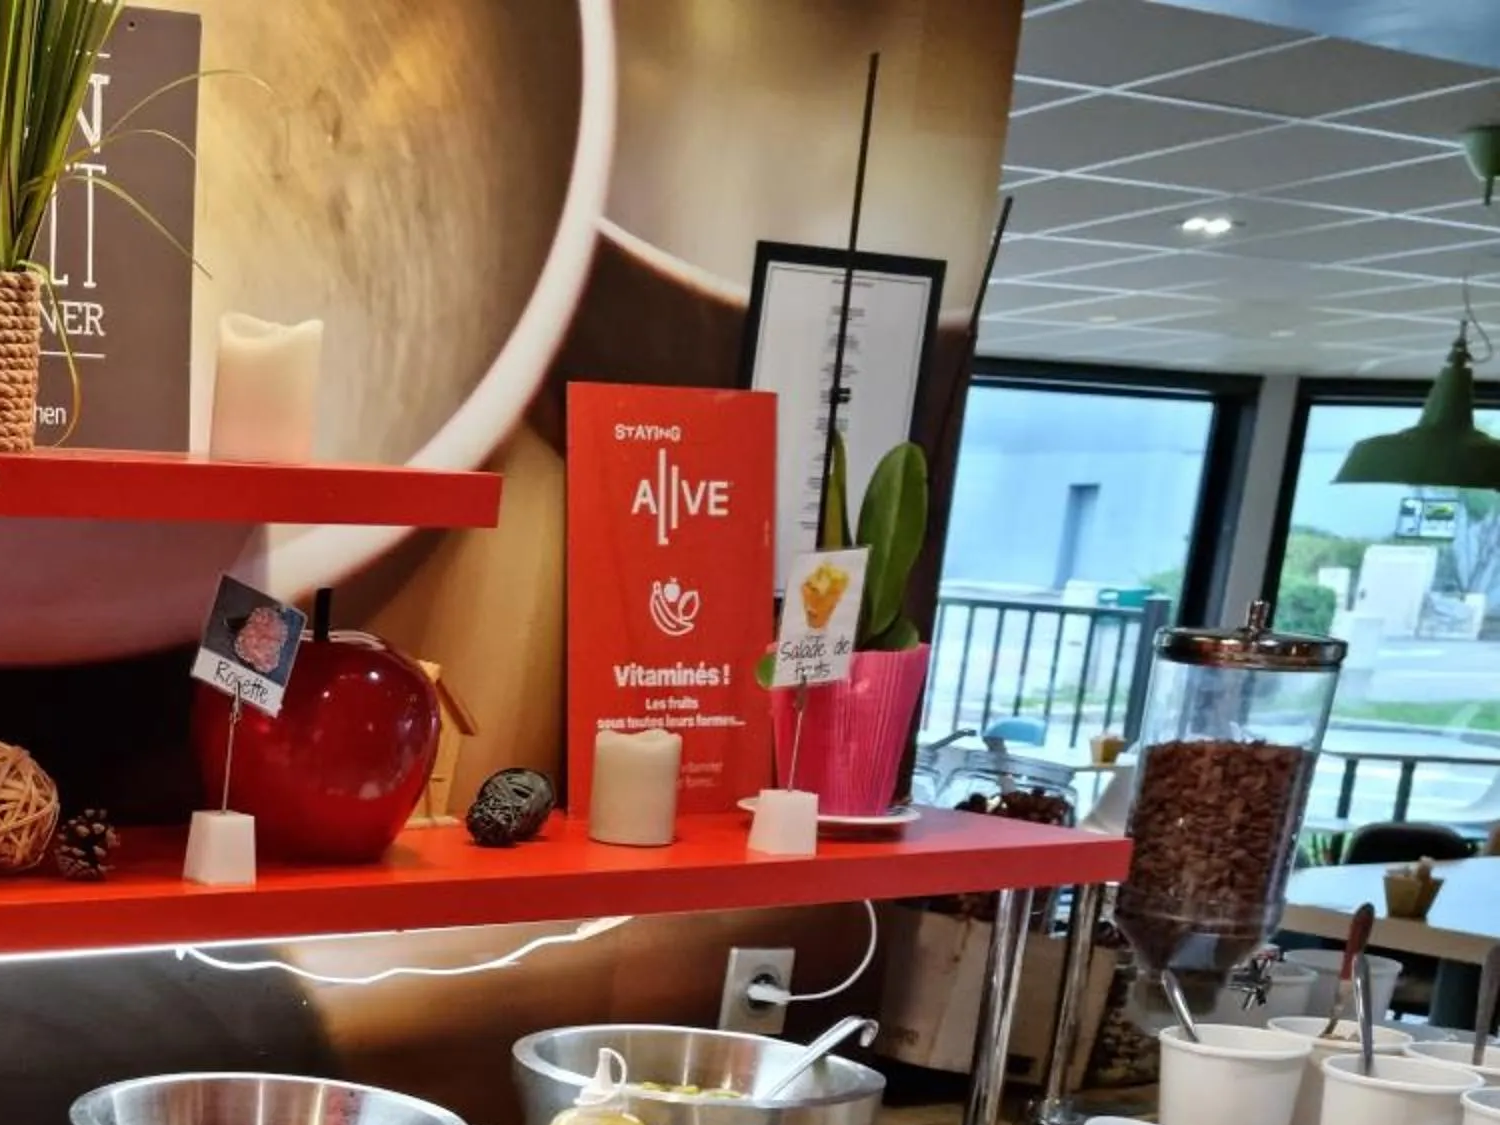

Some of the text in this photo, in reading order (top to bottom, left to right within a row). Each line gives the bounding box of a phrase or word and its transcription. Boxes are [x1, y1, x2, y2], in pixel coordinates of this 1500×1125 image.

[38, 299, 106, 337] NER
[33, 402, 68, 425] hen
[614, 423, 682, 443] STAYING
[631, 447, 730, 546] ALIVE
[613, 661, 720, 687] Vitaminés
